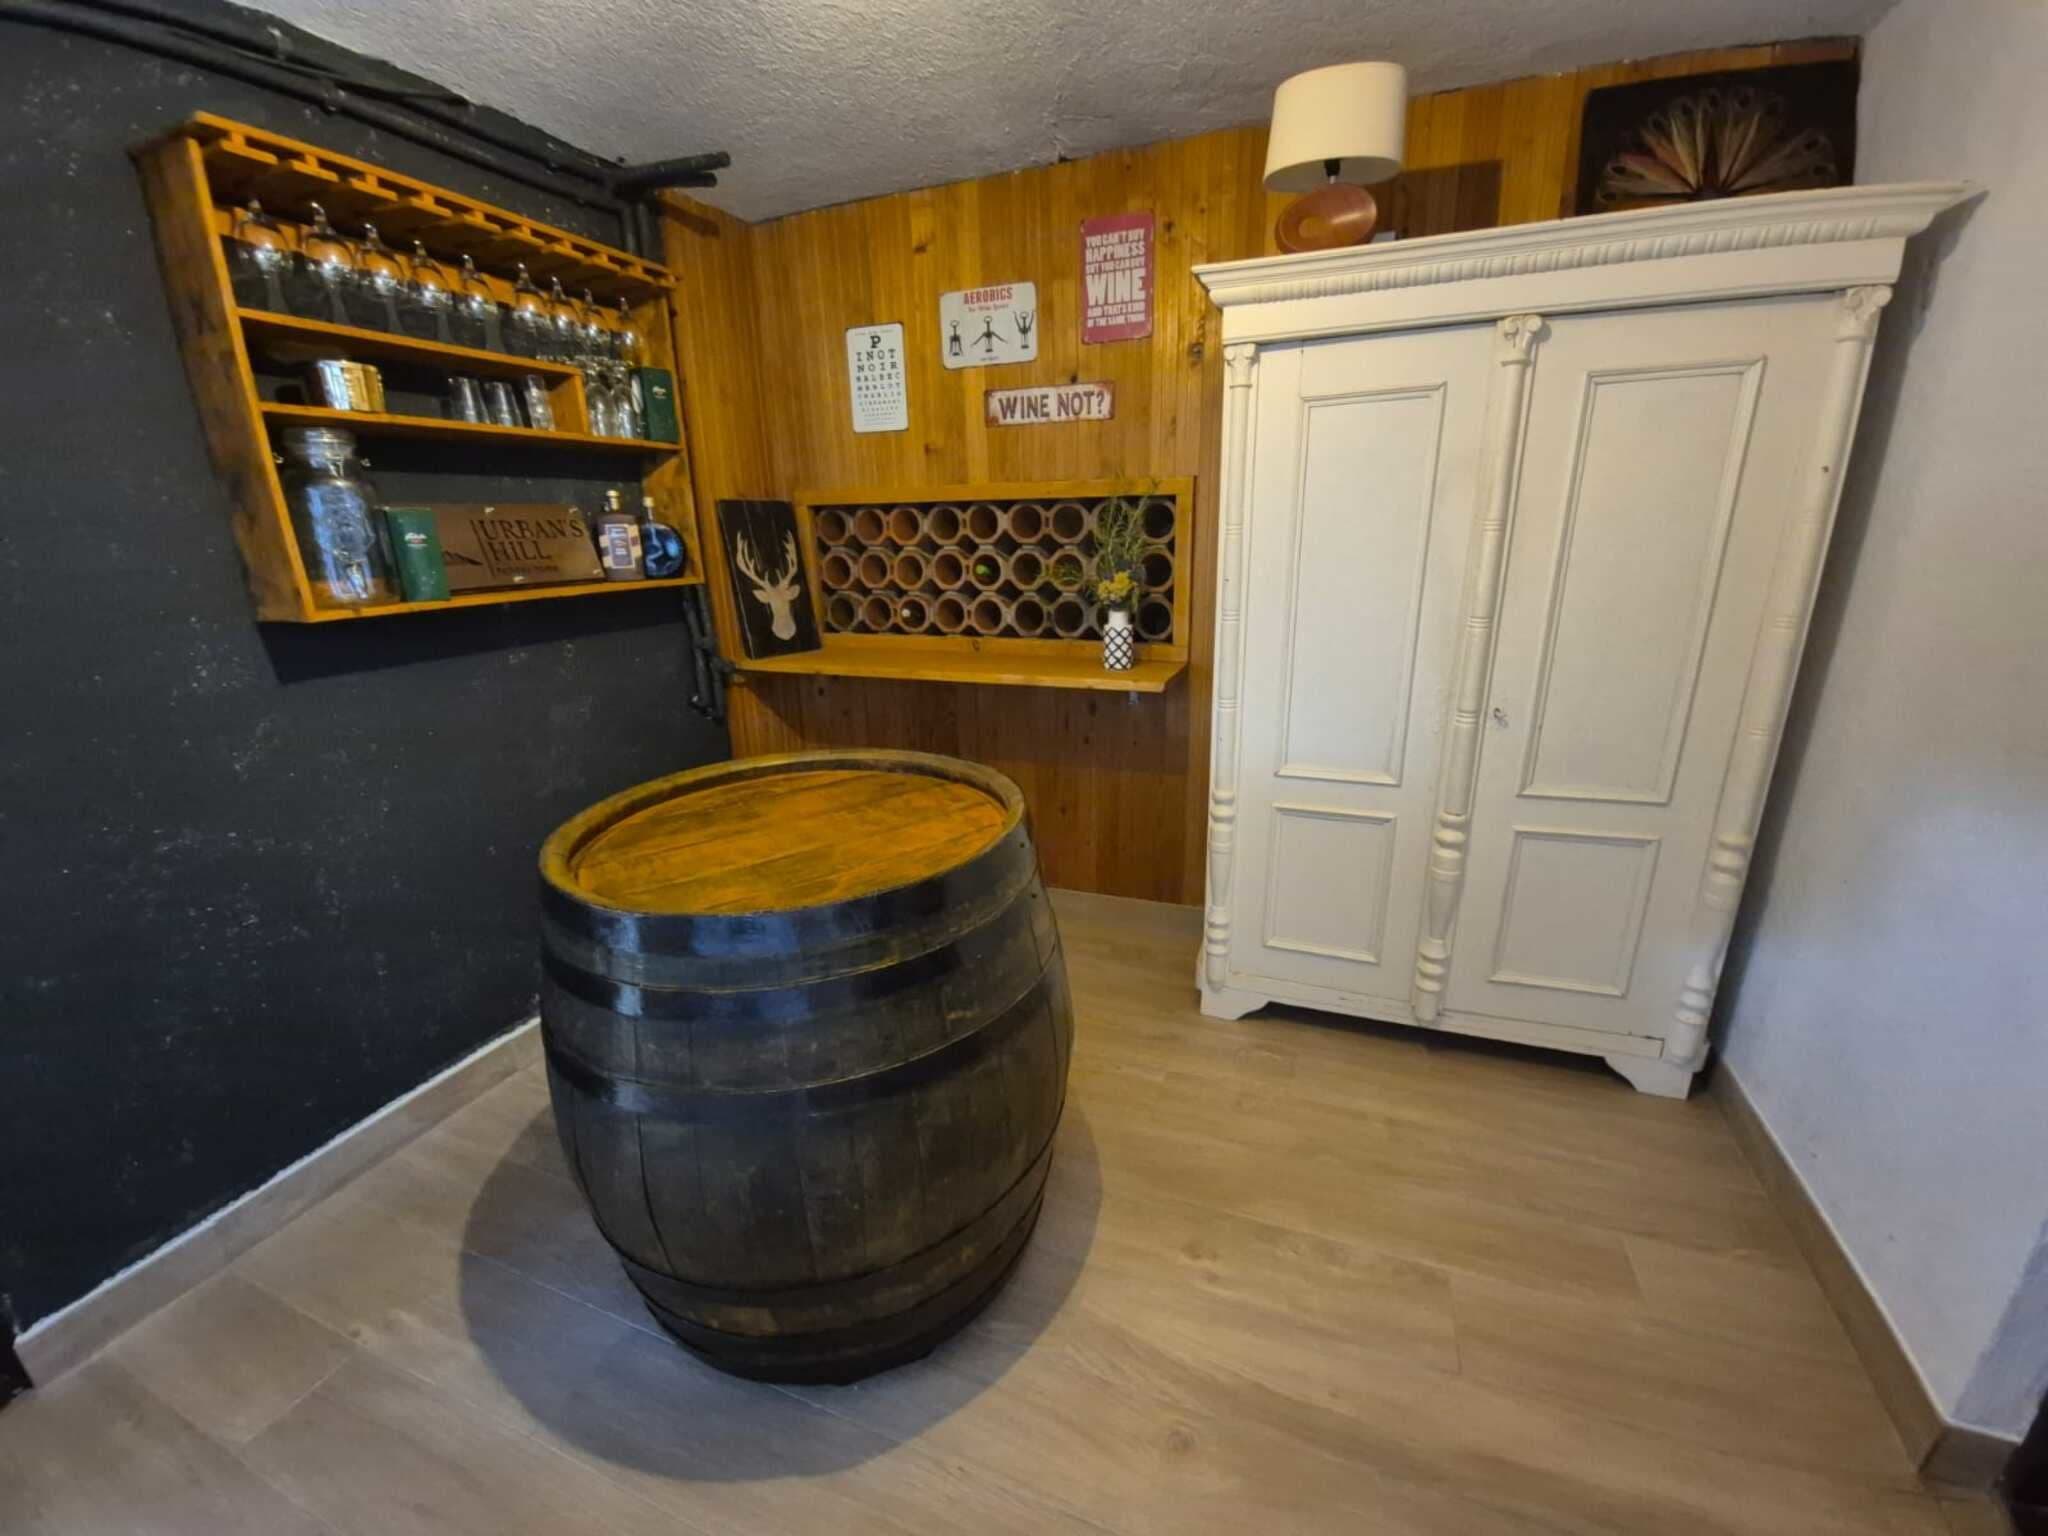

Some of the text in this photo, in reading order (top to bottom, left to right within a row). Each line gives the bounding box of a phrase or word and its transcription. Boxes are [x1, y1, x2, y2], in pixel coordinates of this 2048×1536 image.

[1085, 241, 1145, 263] HAPPINESS
[964, 286, 1013, 305] AEROBICS
[1086, 268, 1146, 306] WINE
[870, 335, 881, 349] P
[998, 390, 1105, 420] WINE NOT?
[479, 519, 584, 541] URBAN'S
[486, 541, 553, 561] HILL
